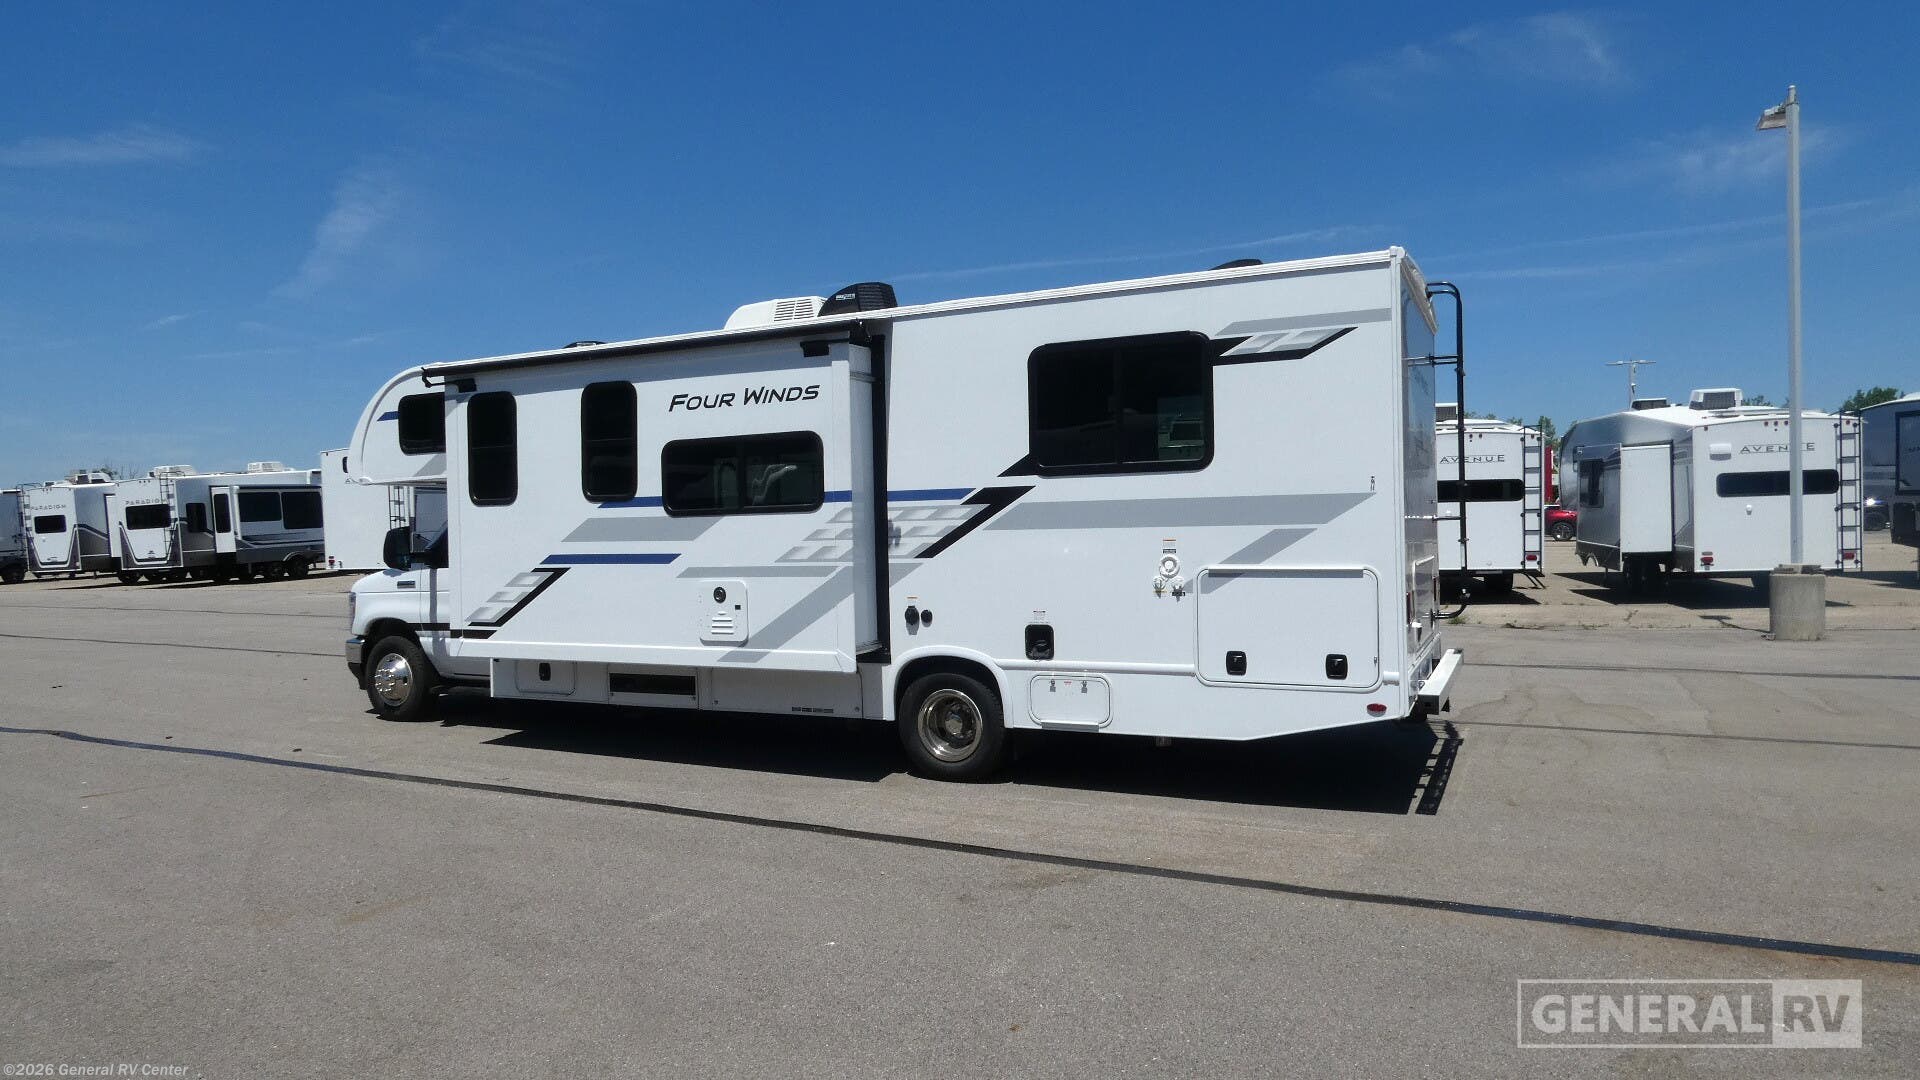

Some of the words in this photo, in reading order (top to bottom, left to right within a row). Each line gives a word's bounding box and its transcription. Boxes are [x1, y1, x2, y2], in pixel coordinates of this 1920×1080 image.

[668, 392, 736, 413] FOUR
[743, 384, 820, 406] WINDS
[1740, 442, 1815, 454] AVENE
